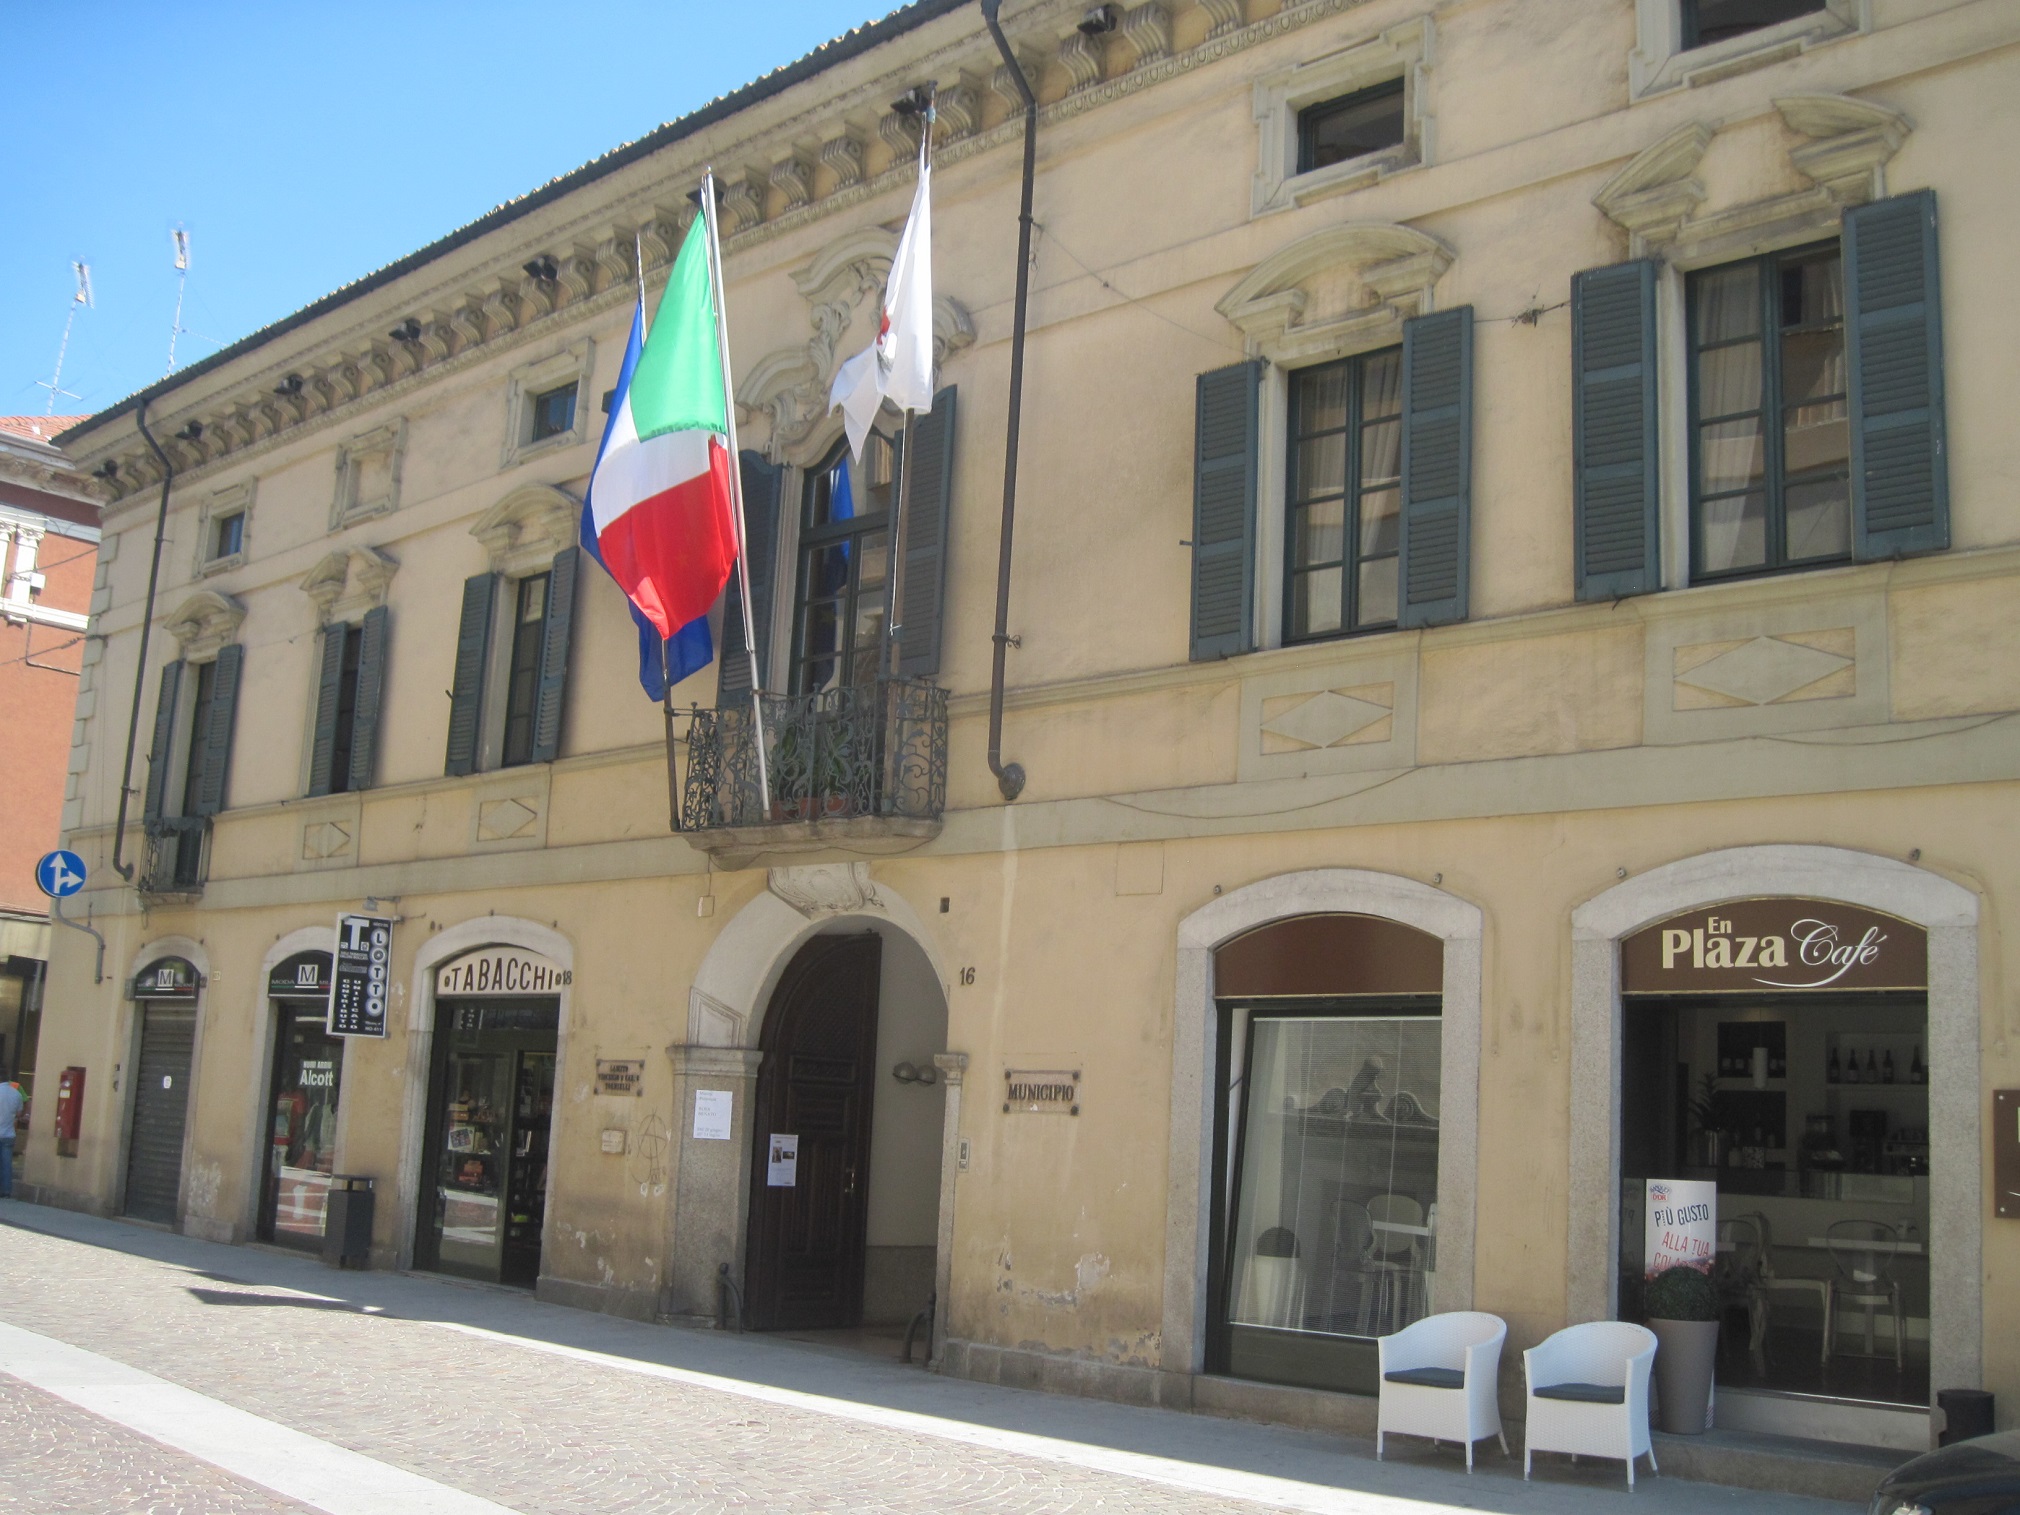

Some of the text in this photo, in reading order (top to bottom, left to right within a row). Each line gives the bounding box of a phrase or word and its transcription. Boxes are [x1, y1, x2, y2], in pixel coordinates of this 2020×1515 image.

[1708, 917, 1732, 934] En
[1662, 918, 1888, 987] Plaza Café
[300, 966, 316, 983] M
[367, 930, 388, 1016] LOTTO
[451, 957, 554, 992] TABACCHI
[562, 969, 573, 986] 18
[959, 966, 976, 986] 16
[339, 979, 350, 1028] CONTRIBUTO
[350, 980, 361, 1029] UNIFICATO
[299, 1069, 334, 1087] Alcott
[1007, 1082, 1075, 1102] MUNICIPIO
[1654, 1203, 1709, 1228] PIÙ GUSTO
[1662, 1231, 1710, 1257] ALLA TUA
